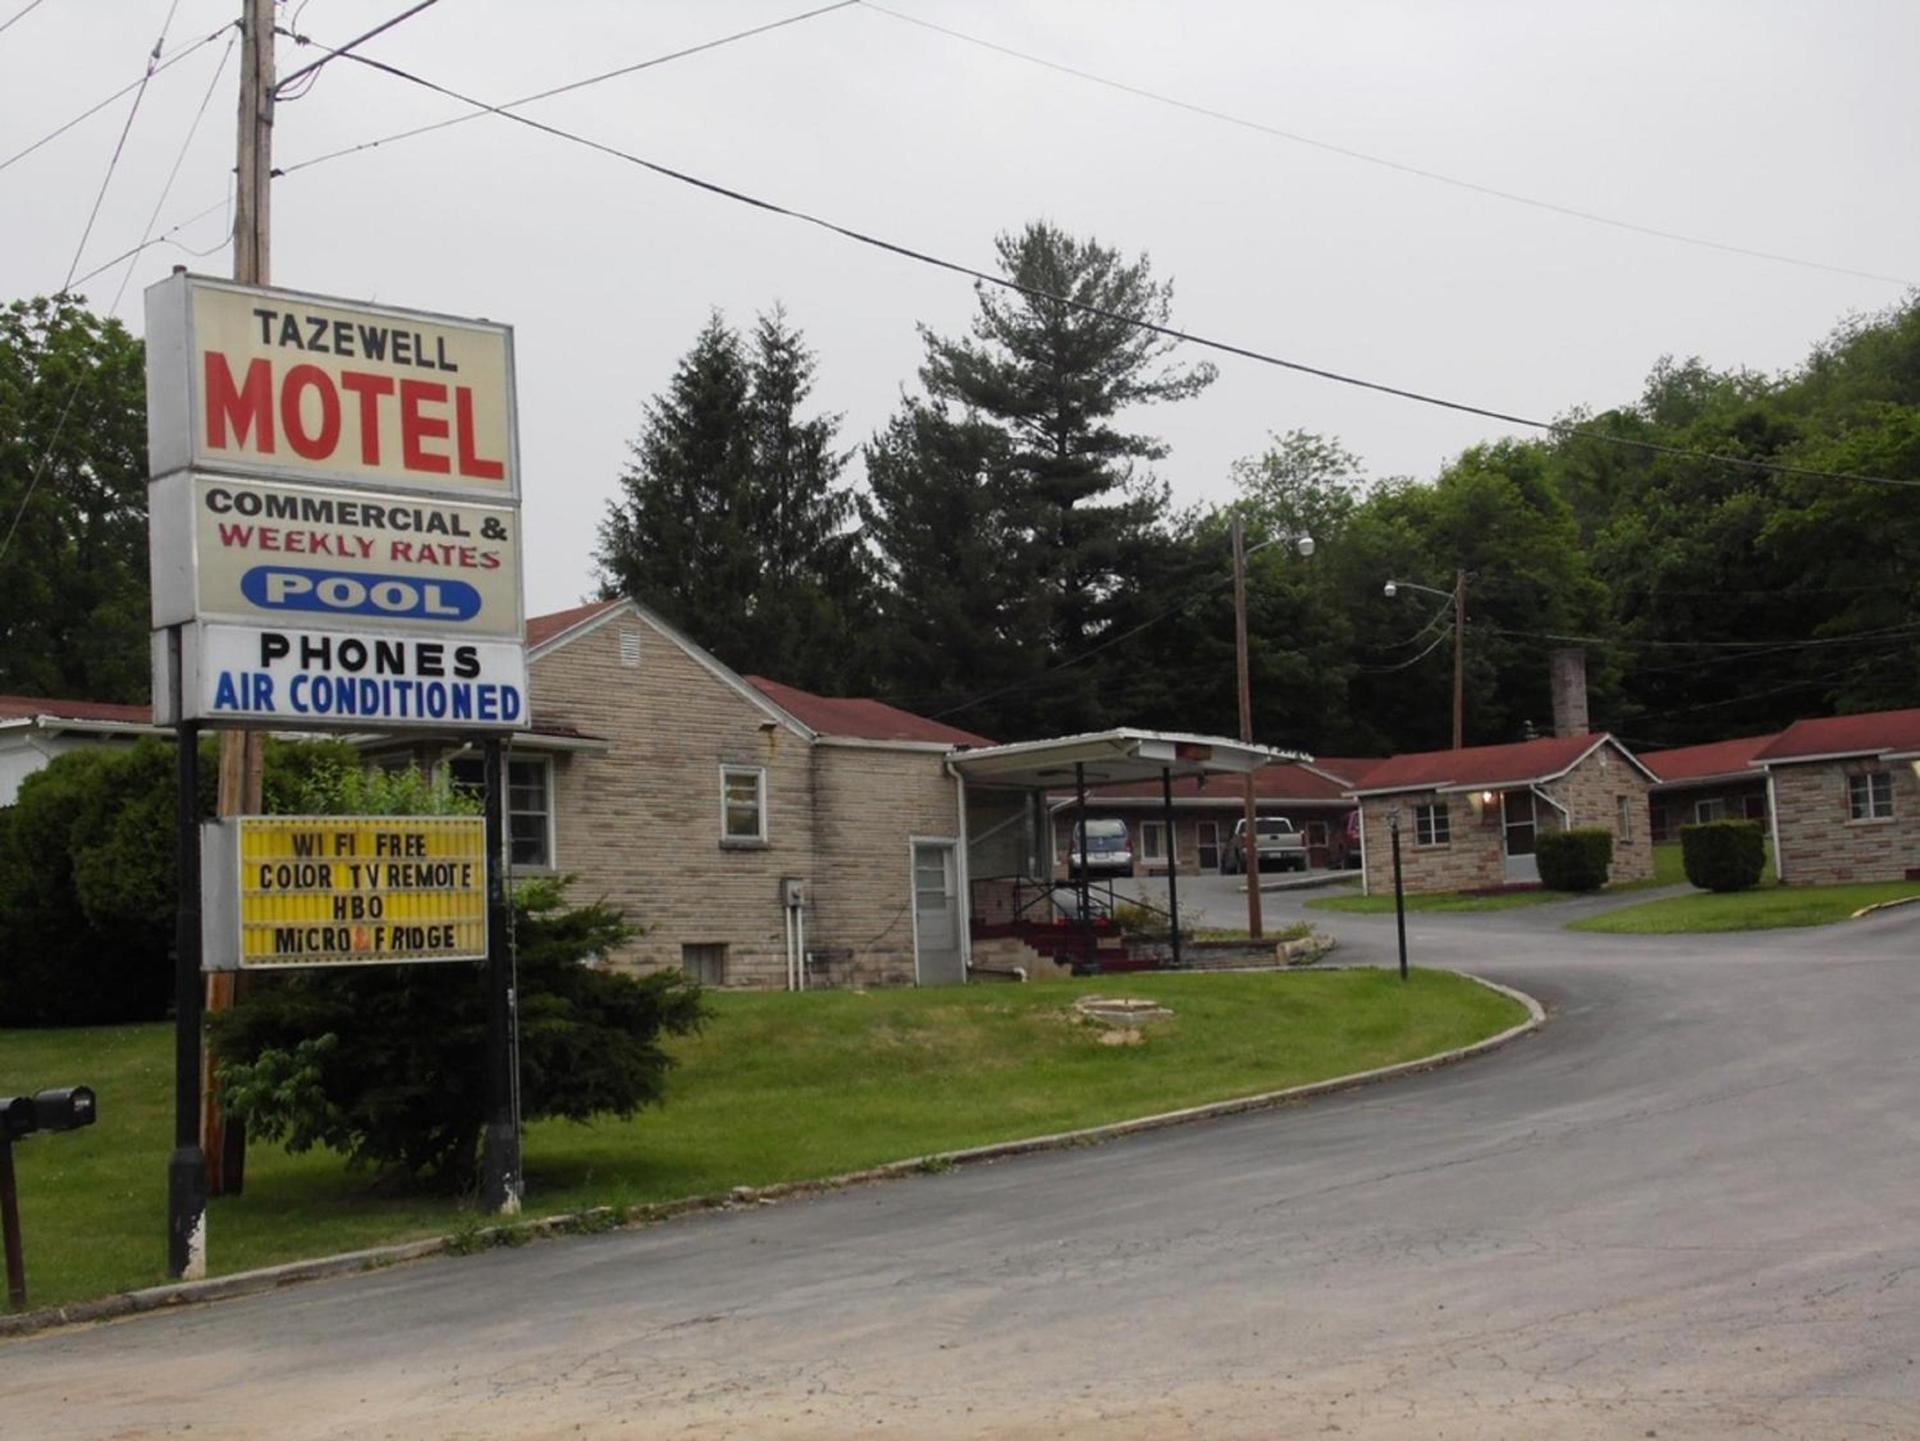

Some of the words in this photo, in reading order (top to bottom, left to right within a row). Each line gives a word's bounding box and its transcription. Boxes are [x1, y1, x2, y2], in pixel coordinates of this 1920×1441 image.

[254, 309, 458, 372] TAZEWELL
[204, 350, 504, 481] MOTEL
[205, 488, 471, 538] COMMERCIAL
[480, 516, 508, 541] &
[218, 522, 376, 560] WEEKLY
[390, 540, 502, 570] RATES
[266, 572, 460, 616] POOL
[260, 632, 482, 679] PHONES
[213, 671, 275, 712] AIR
[289, 674, 521, 722] CONDITIONED
[292, 833, 323, 857] WI
[335, 833, 356, 856] FI
[376, 833, 427, 857] FREE
[260, 864, 333, 889] COLOR
[350, 864, 380, 889] TV
[388, 863, 471, 888] REMOTE
[333, 896, 383, 920] HBO
